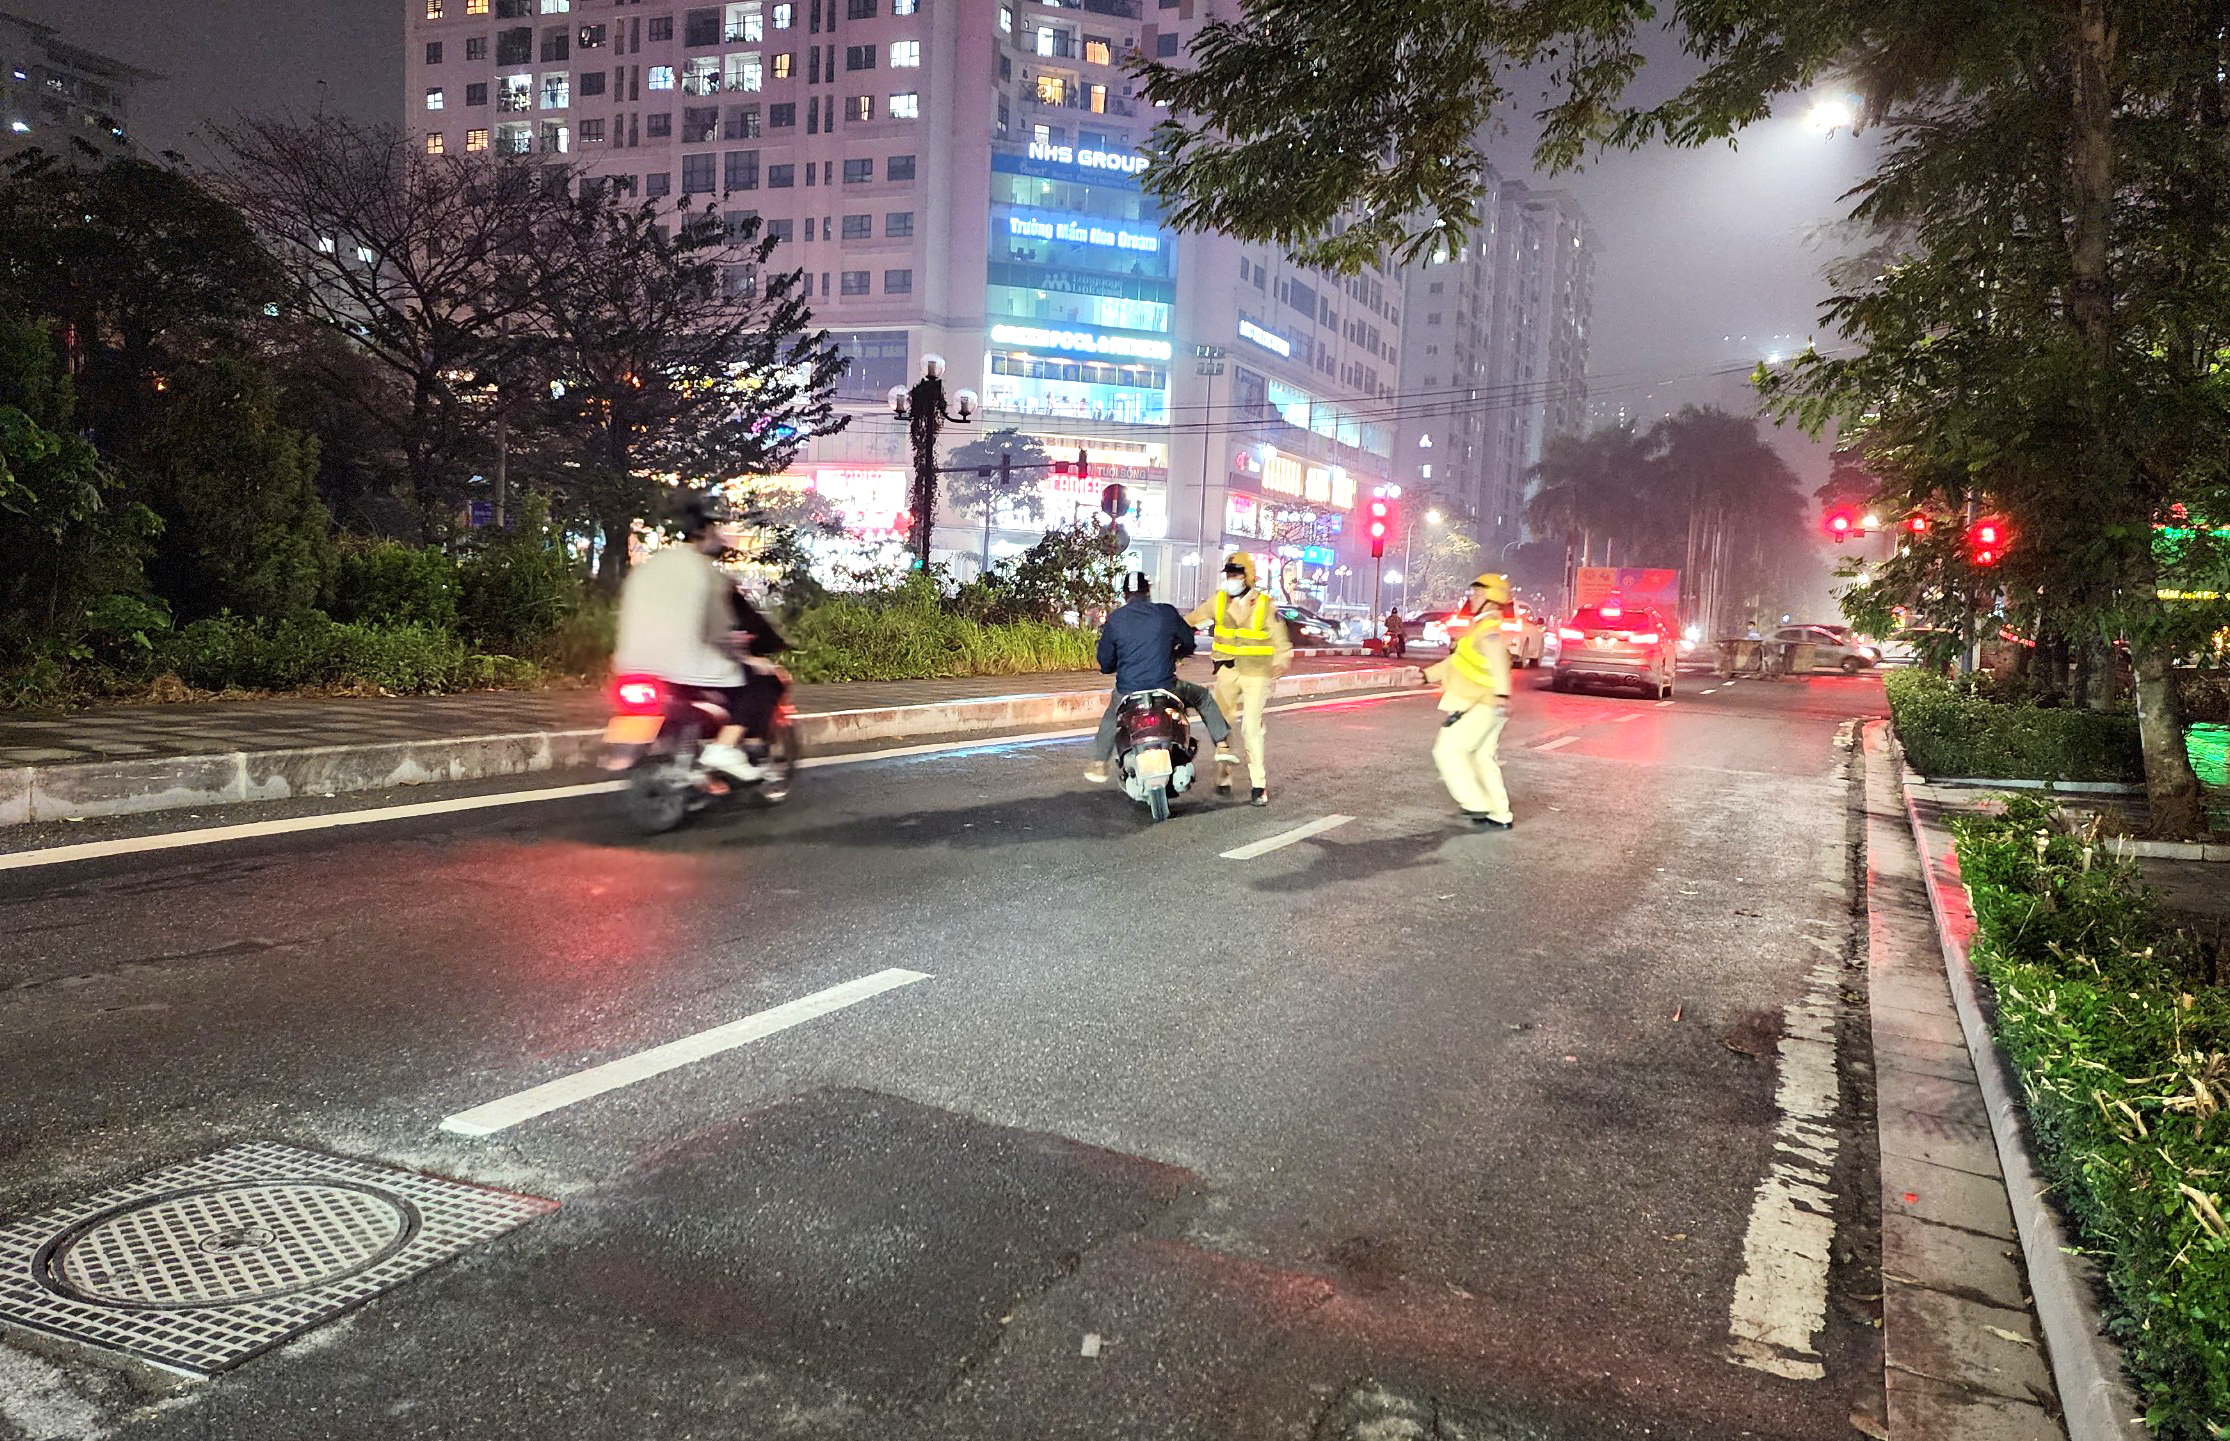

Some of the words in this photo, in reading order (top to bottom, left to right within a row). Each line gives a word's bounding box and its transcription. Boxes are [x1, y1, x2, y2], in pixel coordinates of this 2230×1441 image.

[1029, 142, 1073, 163] NHS
[1078, 149, 1150, 175] GROUP
[1090, 228, 1115, 246] Non
[1050, 331, 1096, 352] POOL
